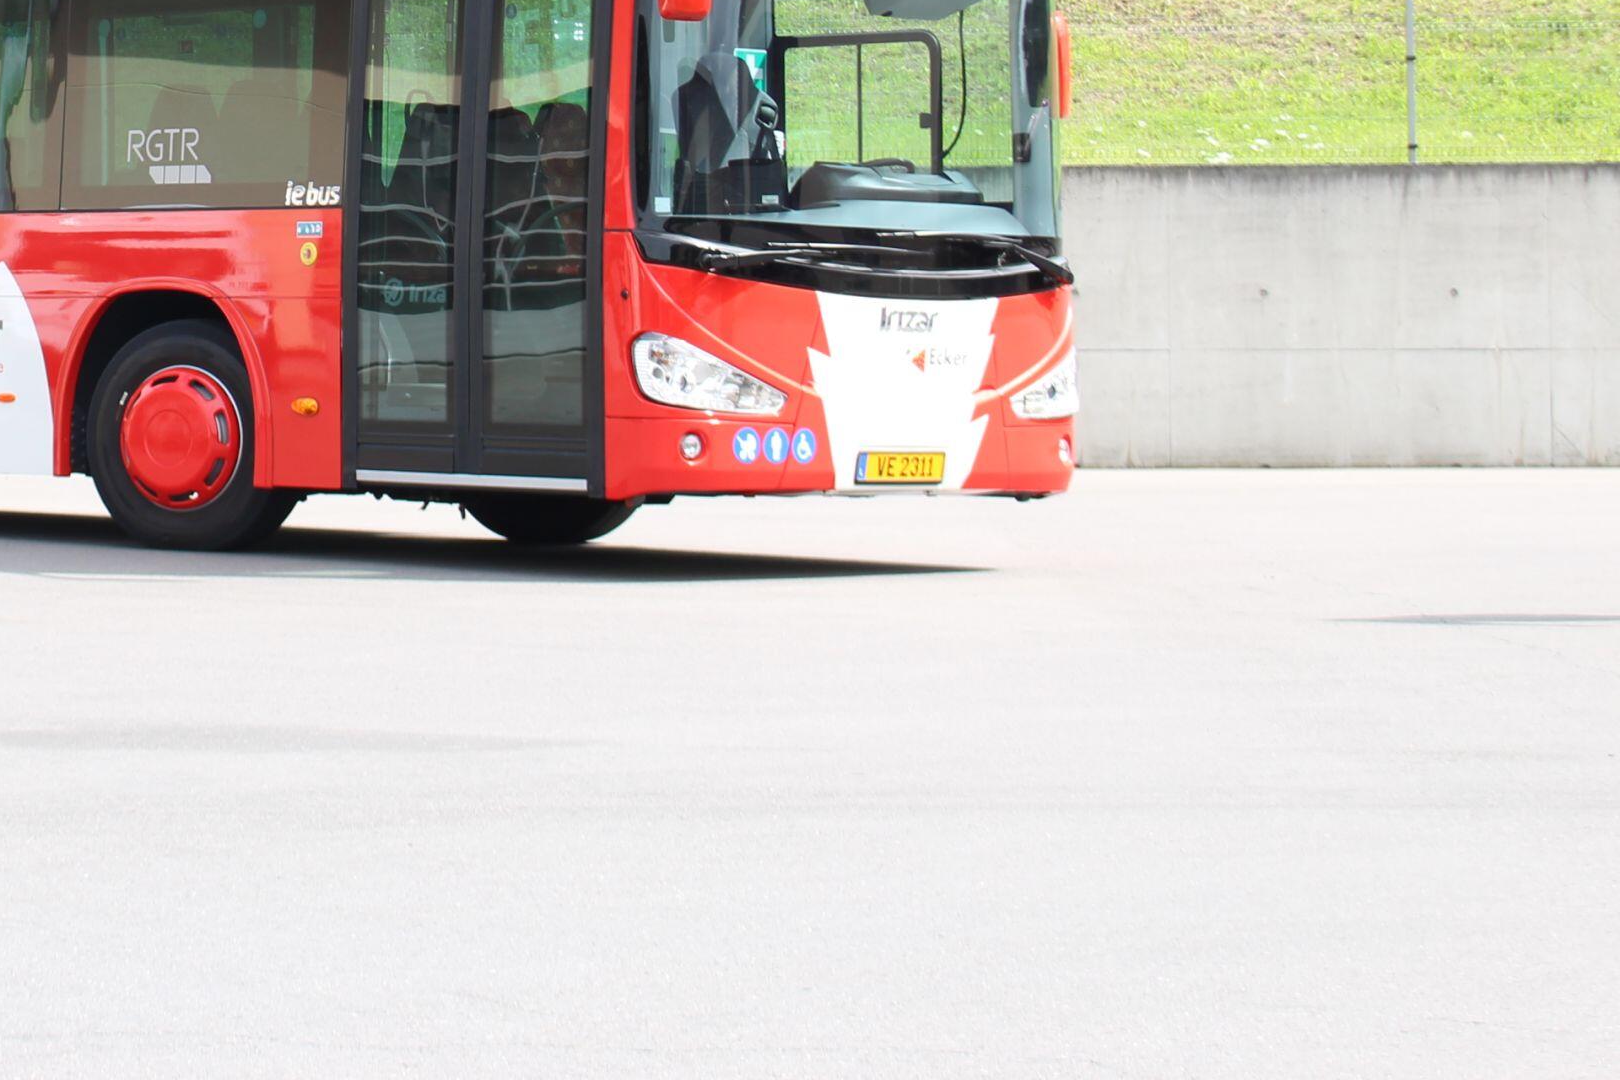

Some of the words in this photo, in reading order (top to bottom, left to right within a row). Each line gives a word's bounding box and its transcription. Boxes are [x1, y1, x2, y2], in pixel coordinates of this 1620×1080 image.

[127, 128, 200, 162] RGTR
[877, 455, 898, 477] VE
[899, 455, 934, 477] 2311
